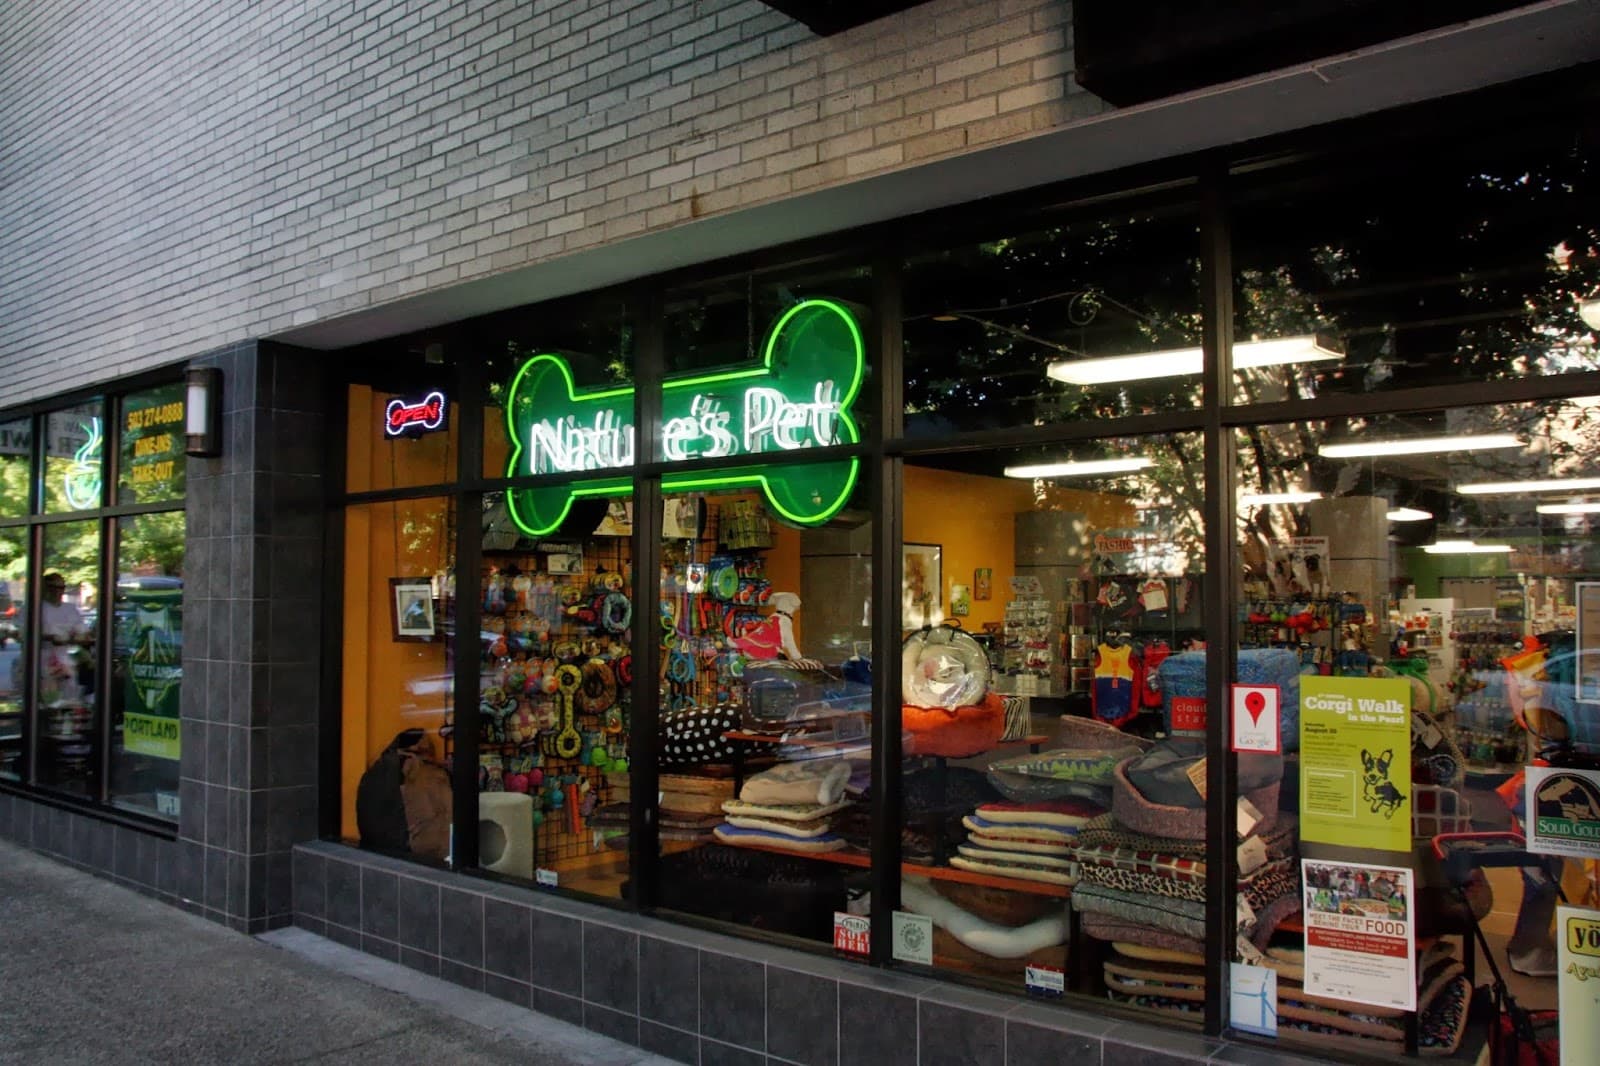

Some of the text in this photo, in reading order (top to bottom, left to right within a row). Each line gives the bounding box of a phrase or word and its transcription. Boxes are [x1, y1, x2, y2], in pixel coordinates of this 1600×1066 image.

[391, 402, 439, 426] OPEN
[530, 379, 842, 474] Natue's Pet
[132, 461, 174, 483] TAKE-OUT
[1304, 696, 1404, 714] Corgi Walk
[1347, 712, 1404, 724] in the Pearl
[1539, 820, 1570, 834] SOLID
[1535, 838, 1578, 847] AUTHORIZED
[1309, 912, 1326, 920] MEET
[1365, 919, 1406, 936] FOOD
